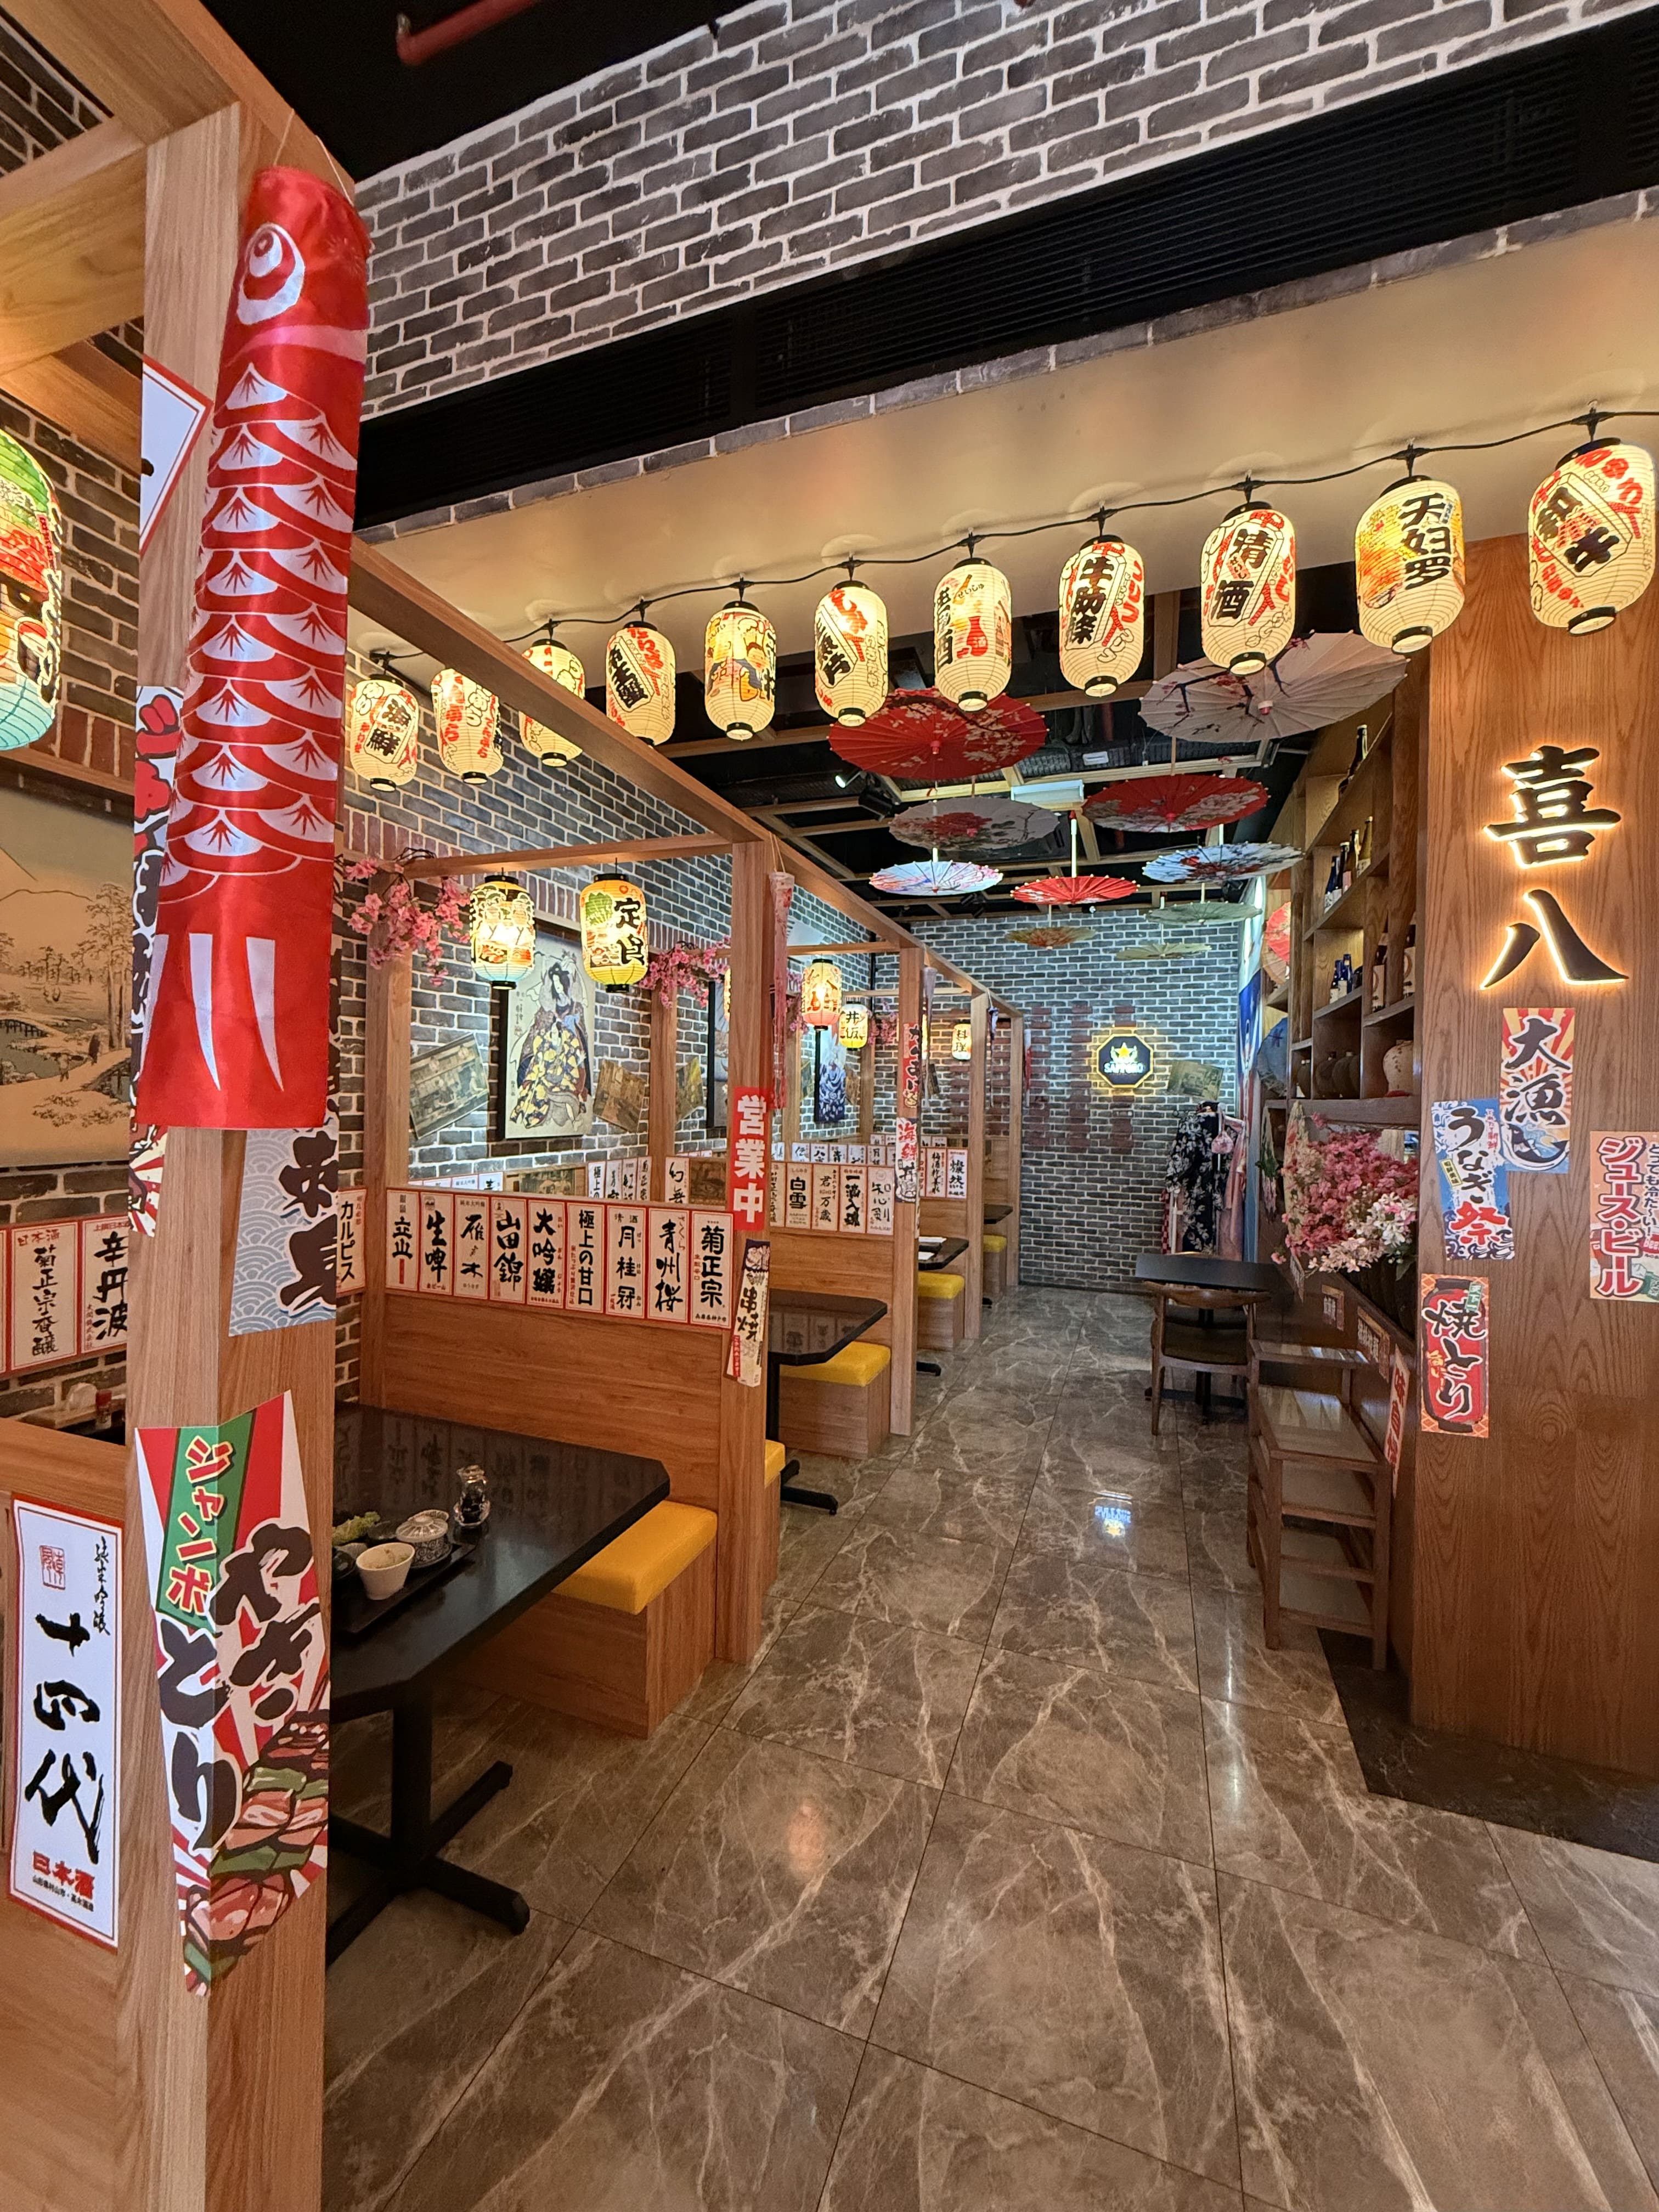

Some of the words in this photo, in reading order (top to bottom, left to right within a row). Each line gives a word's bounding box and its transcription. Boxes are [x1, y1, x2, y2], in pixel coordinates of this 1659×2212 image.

[1211, 529, 1274, 619] 清酒
[1480, 746, 1629, 990] 喜八
[1504, 1018, 1572, 1126] 大漁
[733, 1094, 767, 1223] 営業中
[789, 1176, 808, 1209] 白雪
[1447, 1107, 1506, 1245] うなぎ祭
[18, 1229, 60, 1247] 日本酒
[340, 1201, 356, 1283] カルピス
[392, 1216, 413, 1259] 立山
[425, 1210, 447, 1283] 生啤
[494, 1210, 523, 1291] 山田錦
[578, 1209, 594, 1306] 極上の甘口
[616, 1226, 636, 1310] 月桂冠
[700, 1225, 725, 1308] 菊正宗
[92, 1231, 128, 1340] 辛丹波
[1423, 1300, 1487, 1418] 焼とり
[166, 1436, 233, 1617] ジャンボ
[25, 1612, 105, 1864] 十四代
[32, 1850, 95, 1900] 日本酒
